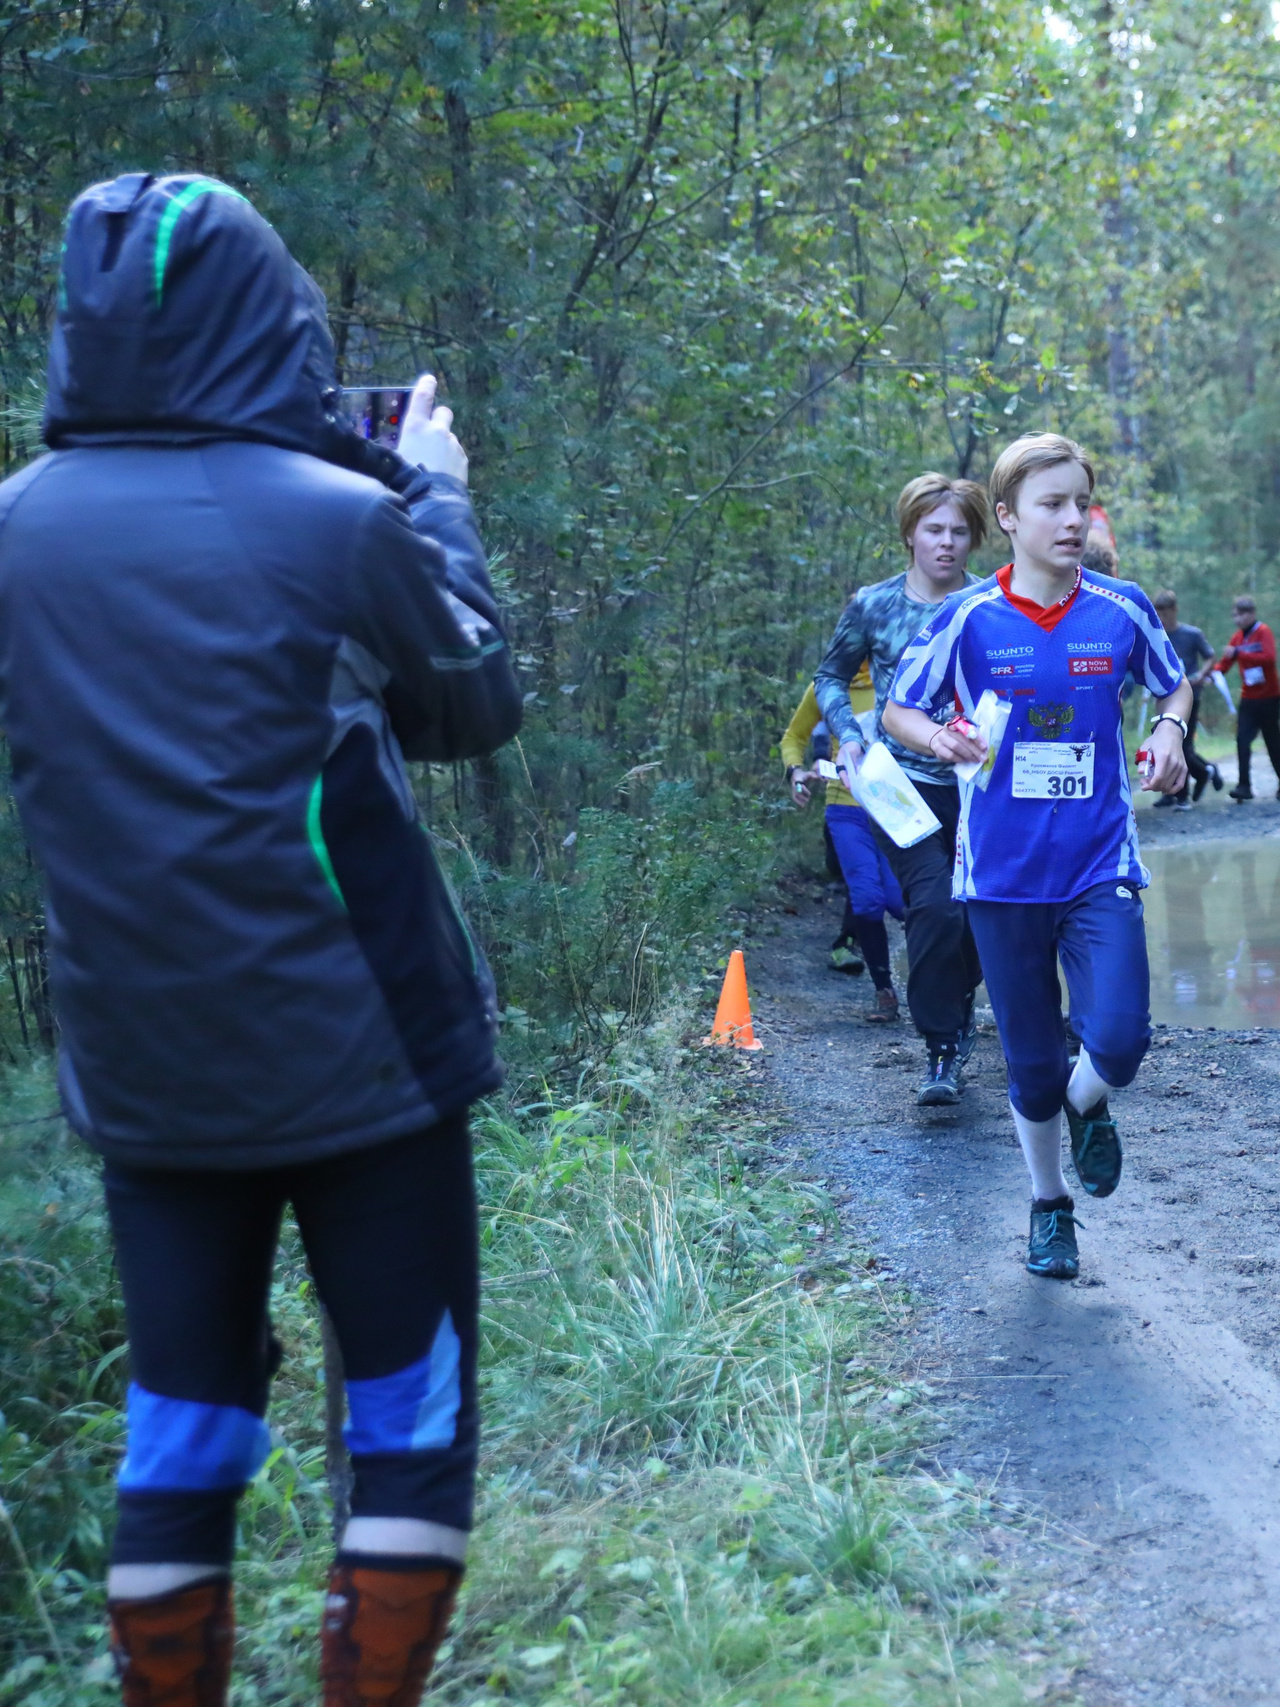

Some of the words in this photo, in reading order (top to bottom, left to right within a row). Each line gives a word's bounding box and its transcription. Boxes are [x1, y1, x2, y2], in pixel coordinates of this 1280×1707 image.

[1067, 642, 1112, 650] SUUNTO
[986, 646, 1034, 656] SUUNTO
[990, 666, 1012, 674] SFR
[1047, 775, 1087, 797] 301
